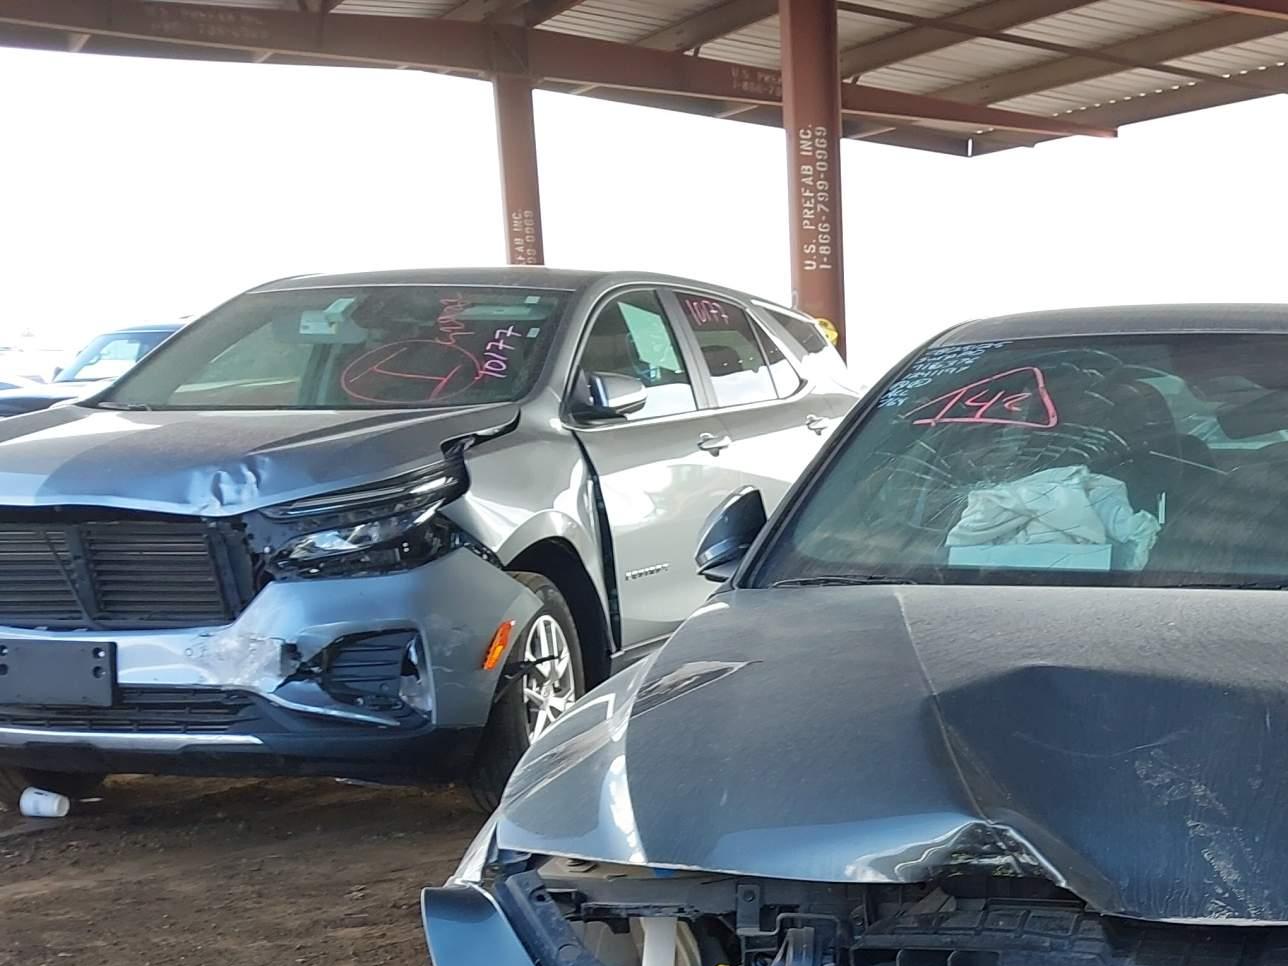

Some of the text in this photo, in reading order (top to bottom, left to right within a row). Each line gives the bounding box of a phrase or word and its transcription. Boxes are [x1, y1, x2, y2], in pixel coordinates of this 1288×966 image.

[799, 124, 817, 271] U.S. PREFAB INC.
[814, 126, 832, 269] 1-866-799-0969
